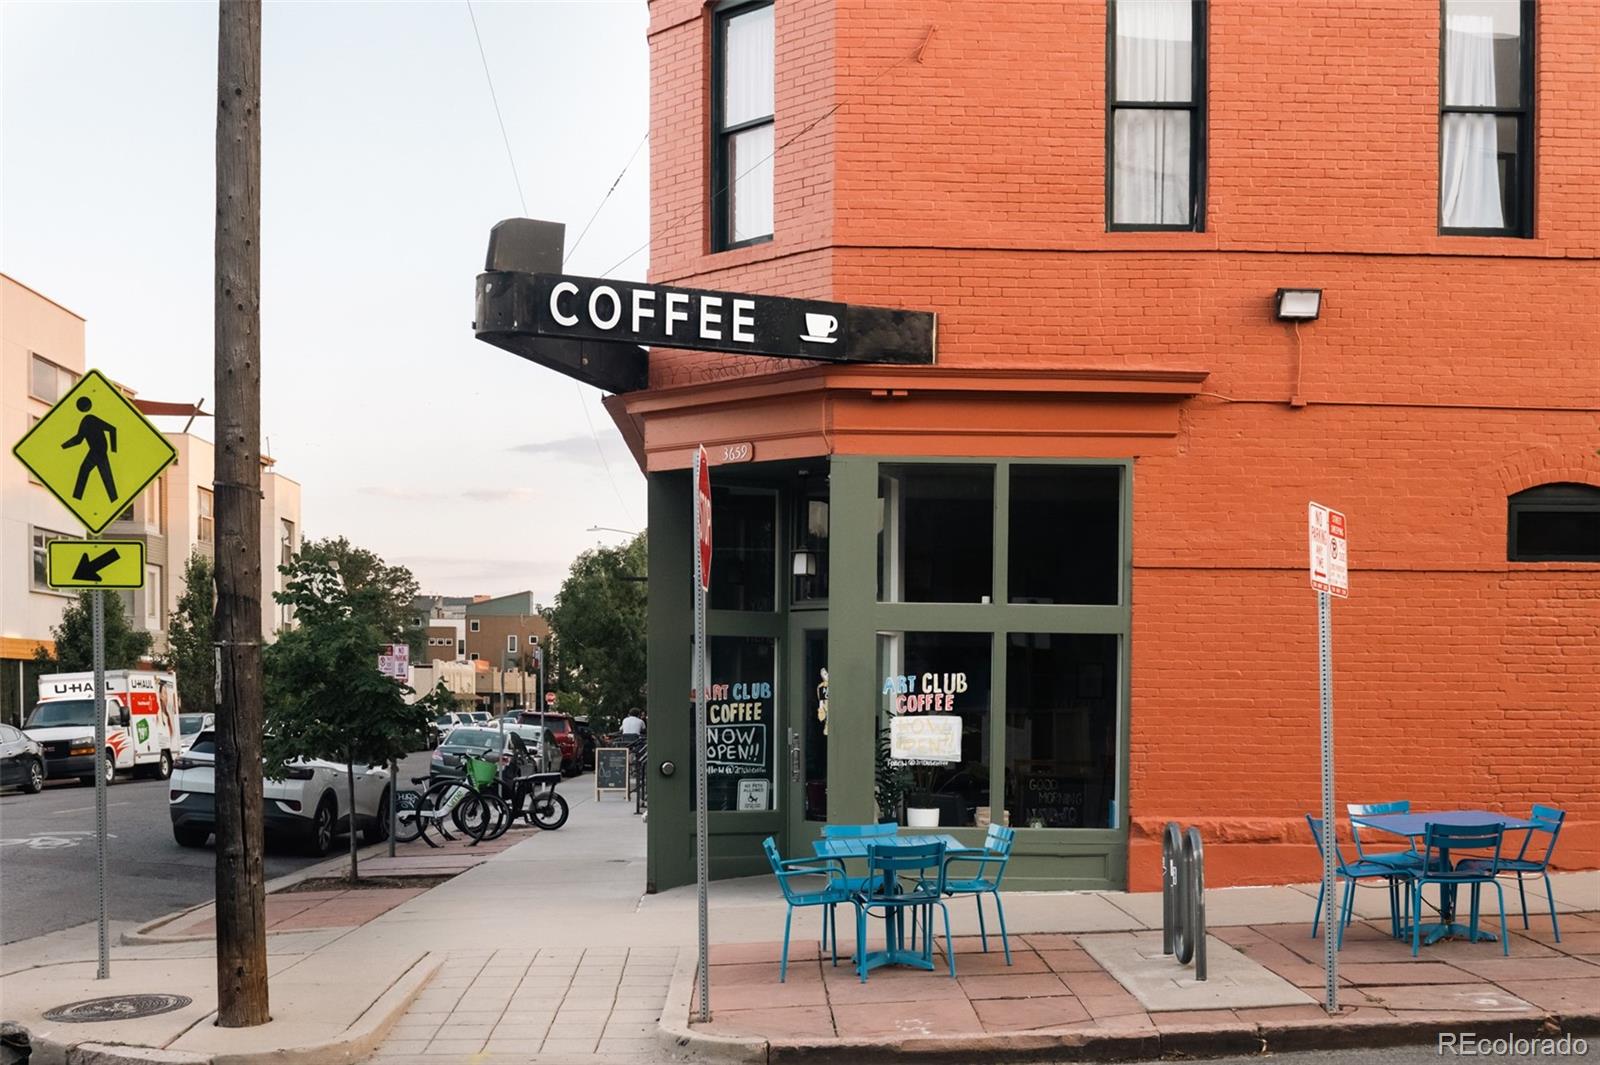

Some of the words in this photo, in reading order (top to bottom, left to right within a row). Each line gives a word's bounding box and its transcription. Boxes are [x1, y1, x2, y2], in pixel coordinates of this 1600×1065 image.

[549, 281, 756, 343] COFFEE
[722, 444, 748, 461] 3659
[54, 680, 114, 694] U-HAL
[131, 679, 154, 689] U-HAUL
[732, 682, 772, 700] CLUB
[882, 675, 917, 695] ART
[922, 672, 968, 694] CLUB
[896, 692, 955, 713] COFFEE
[710, 702, 763, 723] COFFEE
[707, 727, 756, 745] NOW
[707, 743, 760, 761] OPEN!!
